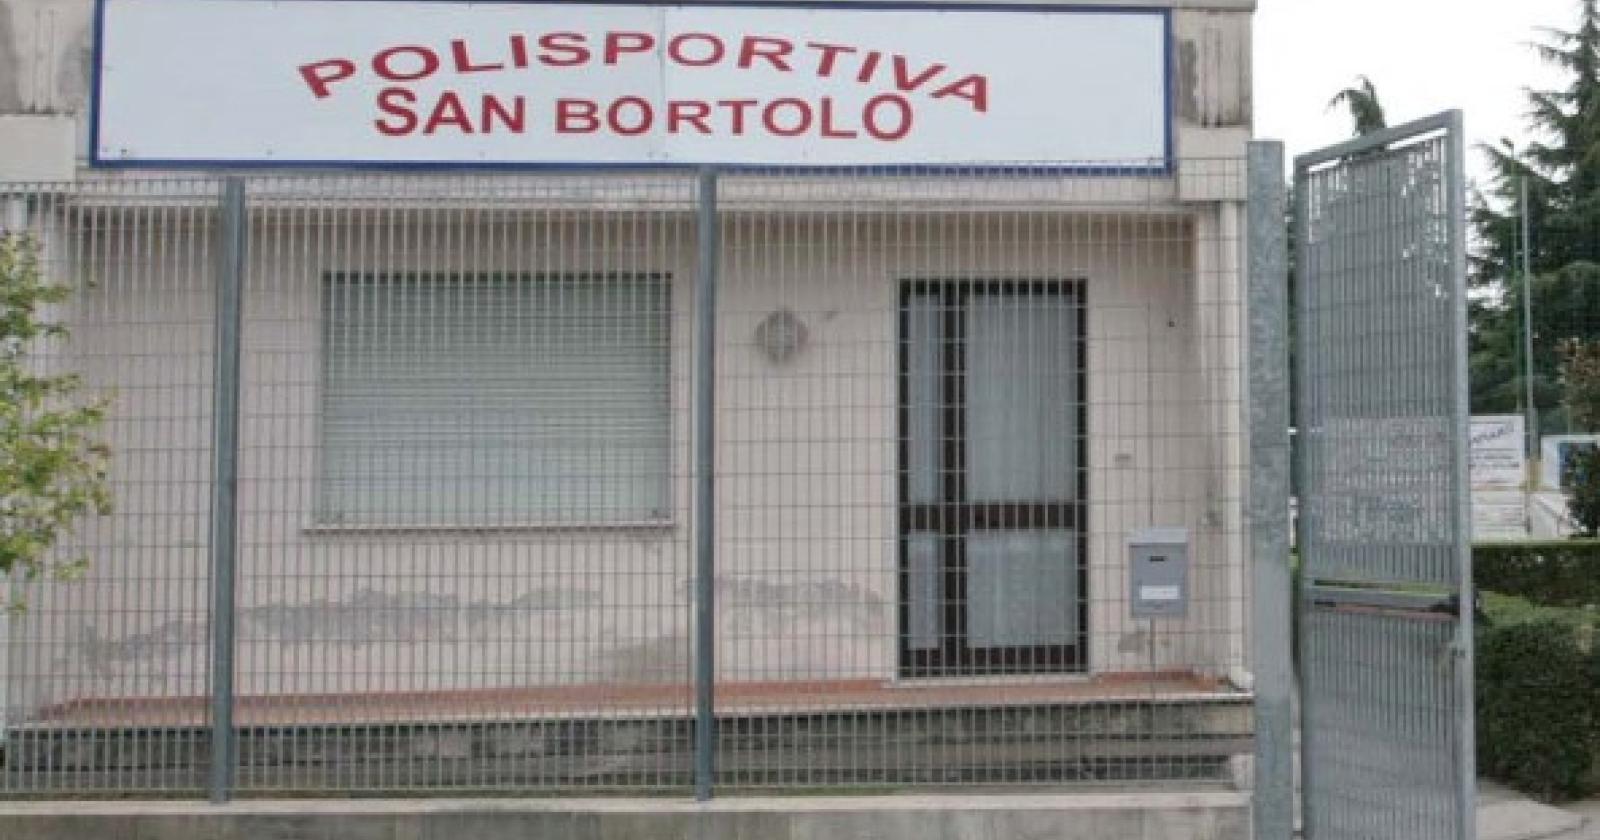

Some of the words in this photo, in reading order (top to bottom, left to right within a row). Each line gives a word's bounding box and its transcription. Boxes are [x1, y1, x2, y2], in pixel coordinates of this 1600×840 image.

[299, 32, 990, 113] POLISPORTIVA
[375, 87, 527, 137] SAN
[554, 94, 913, 142] BORTOLO
